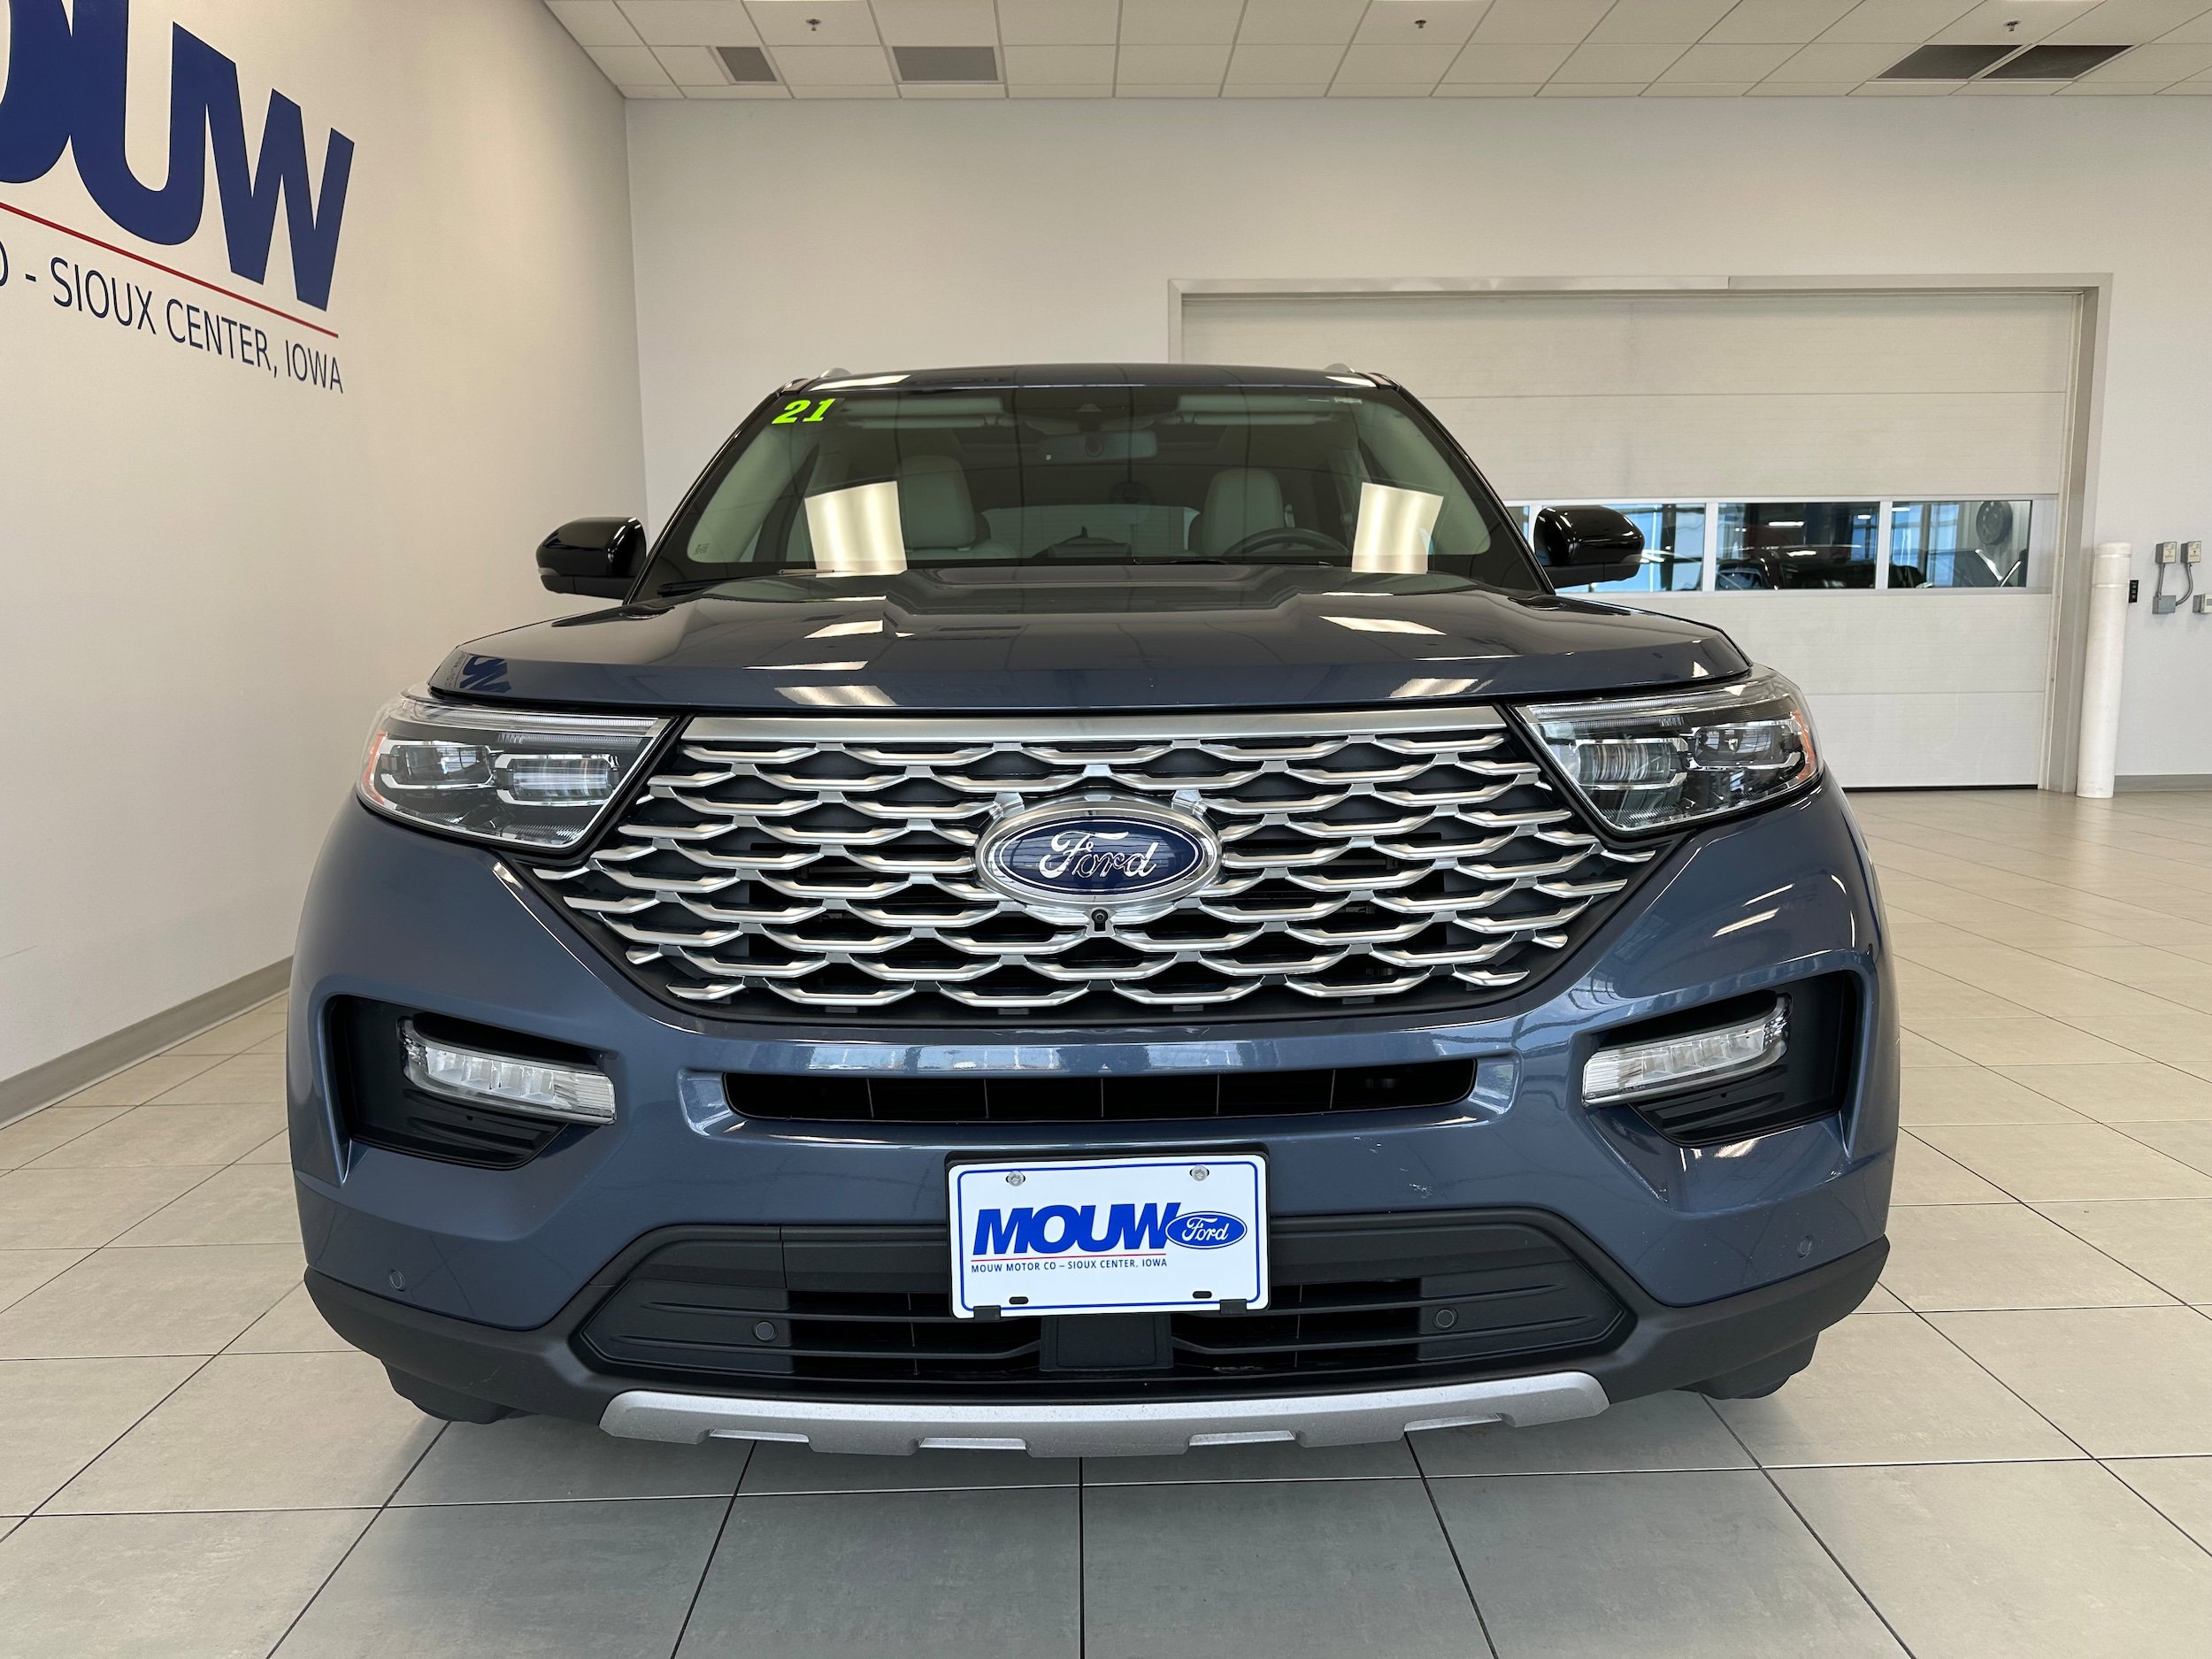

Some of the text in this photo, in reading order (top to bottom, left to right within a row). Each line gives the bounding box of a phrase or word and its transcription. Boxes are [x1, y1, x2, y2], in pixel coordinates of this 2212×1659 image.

[50, 257, 157, 335] SIOUX
[166, 298, 278, 379] CENTER,
[285, 340, 343, 394] IOWA
[772, 398, 836, 425] 21
[1039, 831, 1162, 879] Ford
[972, 1202, 1181, 1255] MOUW
[1182, 1217, 1229, 1242] Ford
[971, 1264, 1002, 1273] MOUW
[1006, 1263, 1041, 1271] MOTOR
[1068, 1261, 1096, 1270] SIOUX
[1141, 1258, 1167, 1267] IOWA
